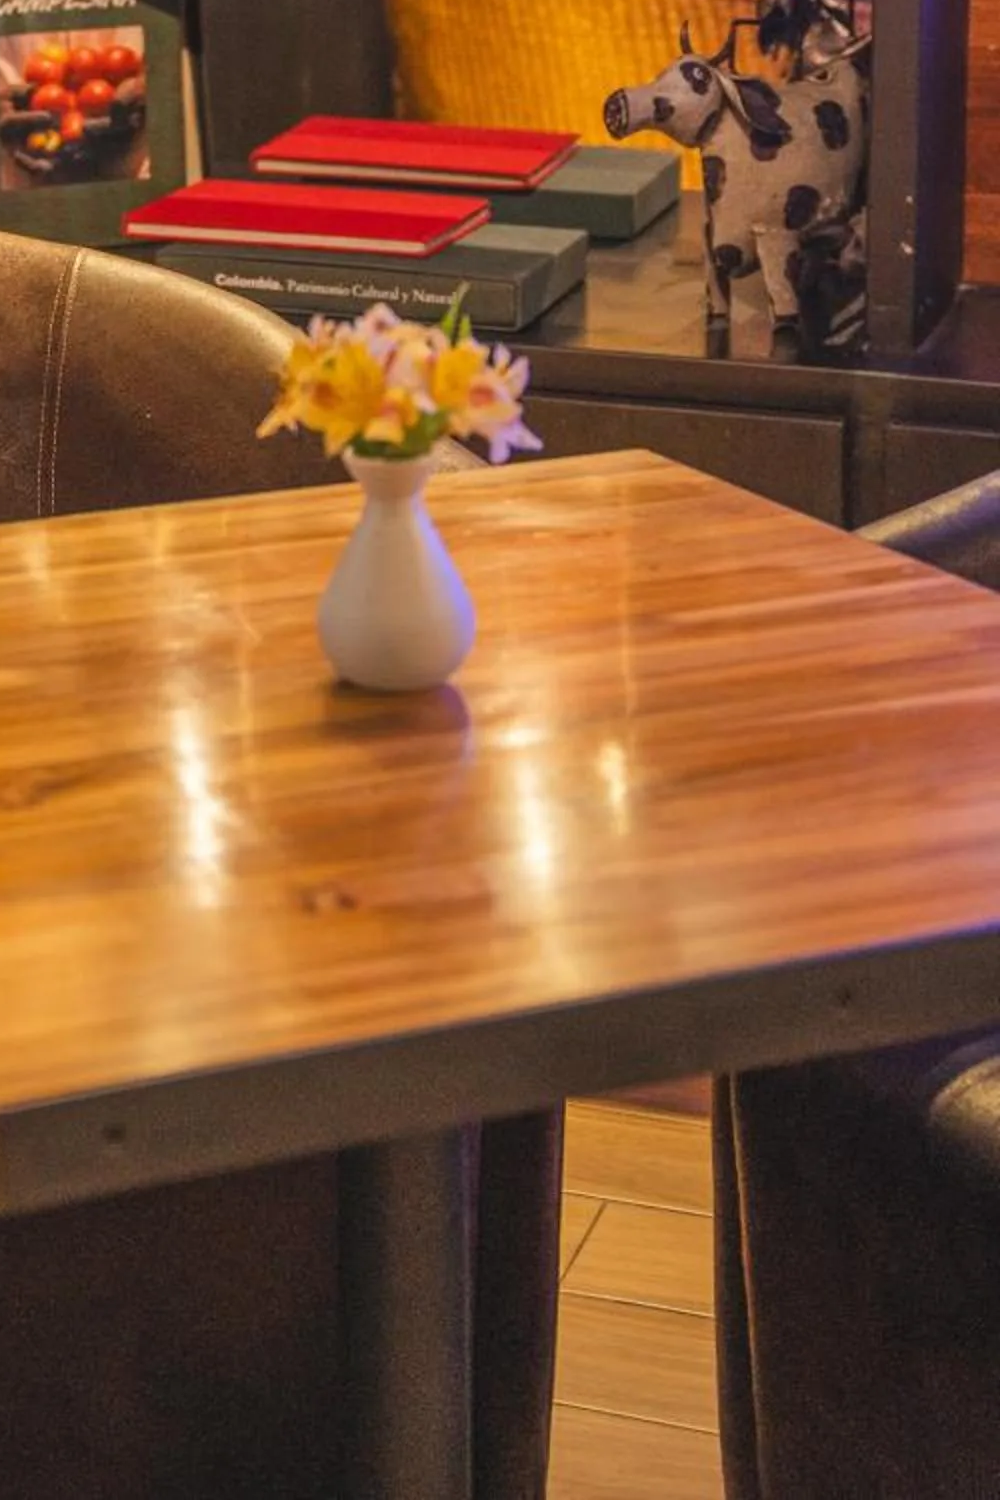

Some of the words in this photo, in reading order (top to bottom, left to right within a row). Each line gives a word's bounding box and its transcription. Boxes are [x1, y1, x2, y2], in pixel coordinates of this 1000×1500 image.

[287, 278, 349, 296] Patrimonio
[351, 284, 399, 301] Cultural
[401, 290, 408, 304] y
